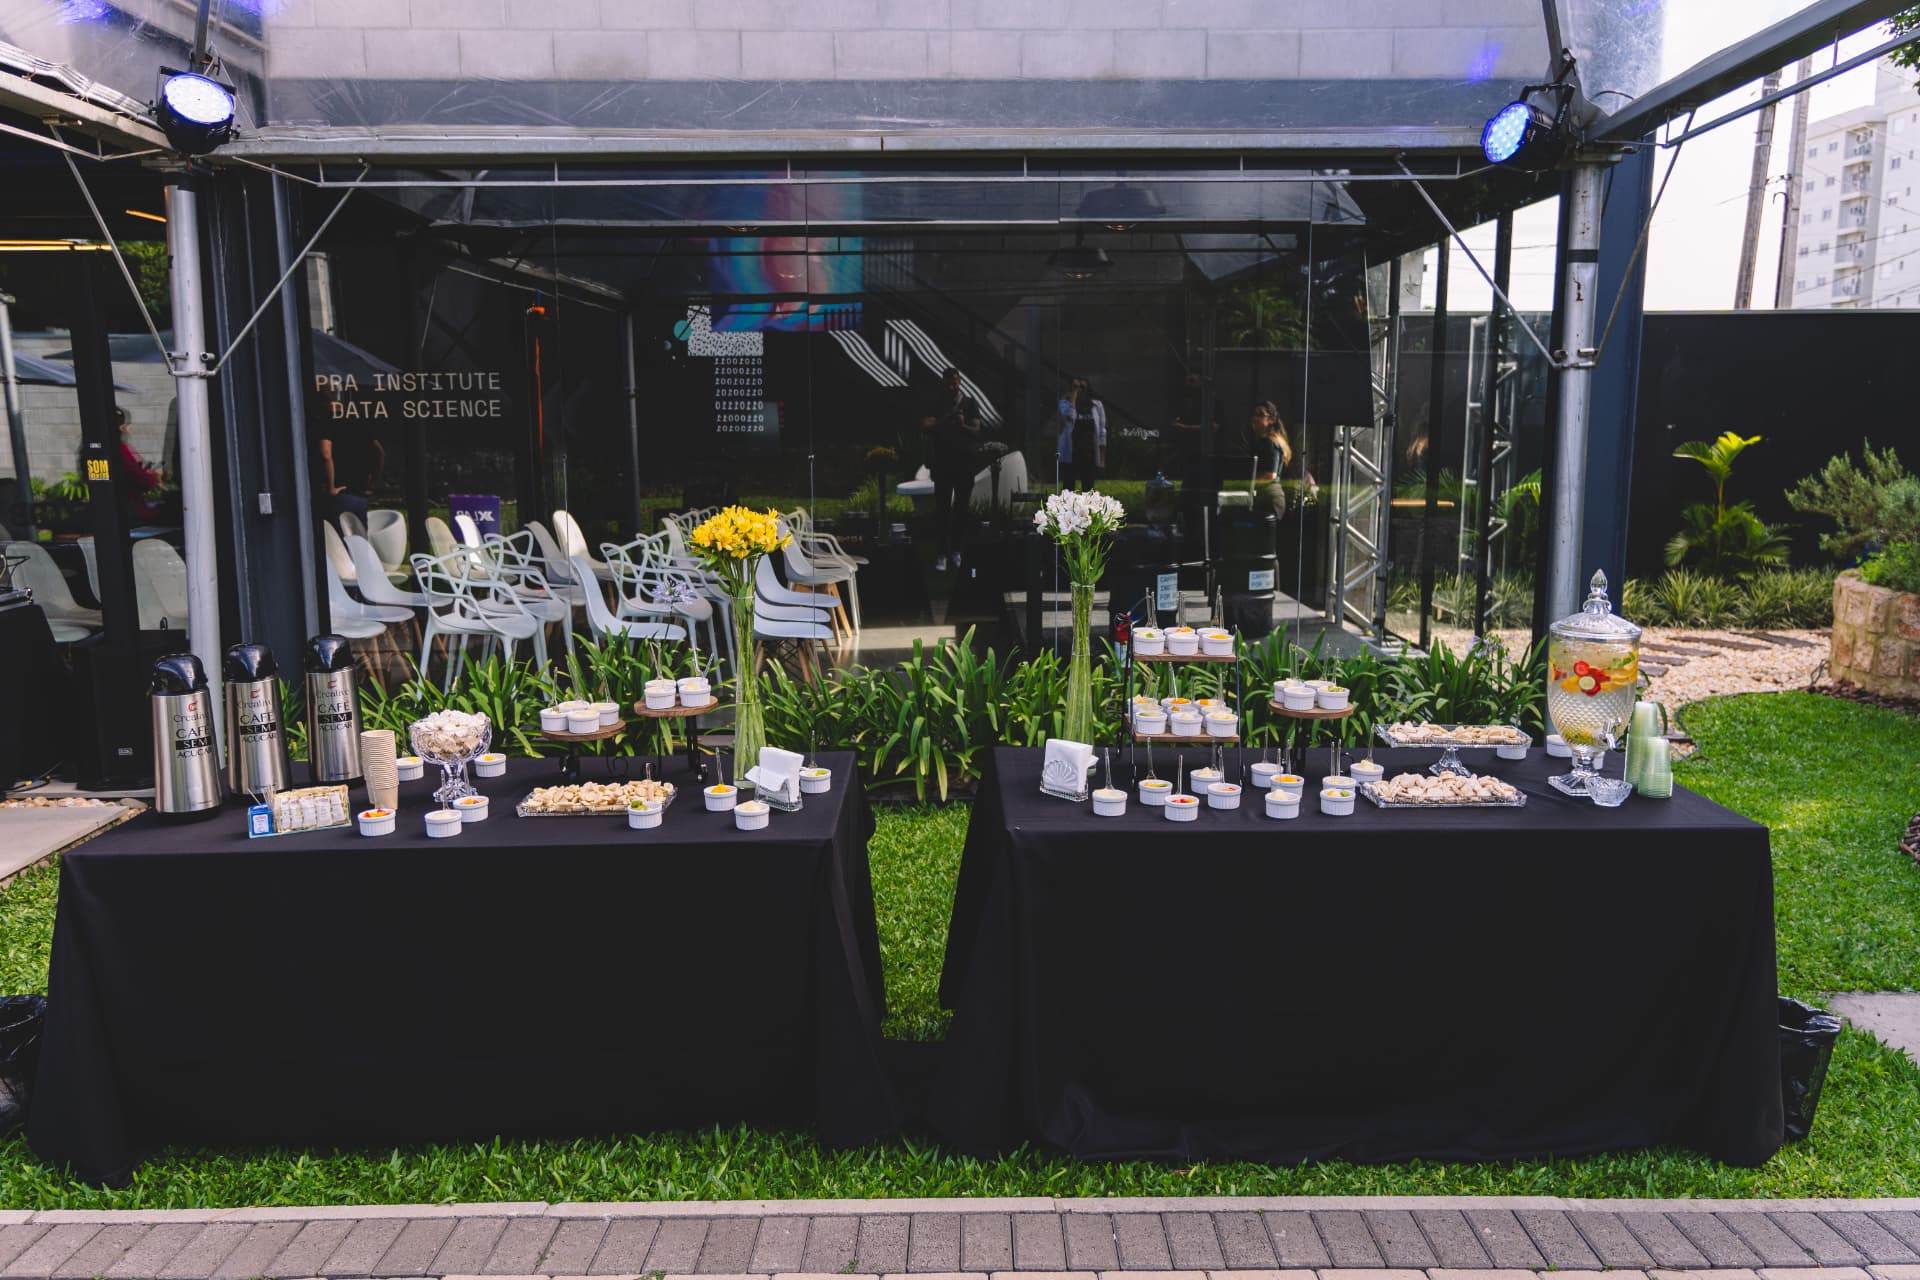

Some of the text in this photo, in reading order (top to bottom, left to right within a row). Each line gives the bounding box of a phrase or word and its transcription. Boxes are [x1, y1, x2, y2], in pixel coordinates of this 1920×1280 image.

[315, 372, 501, 392] PRA INSTITUTE
[332, 400, 501, 419] DATA SCIENCE
[246, 723, 271, 734] SEM
[183, 738, 208, 749] SEM
